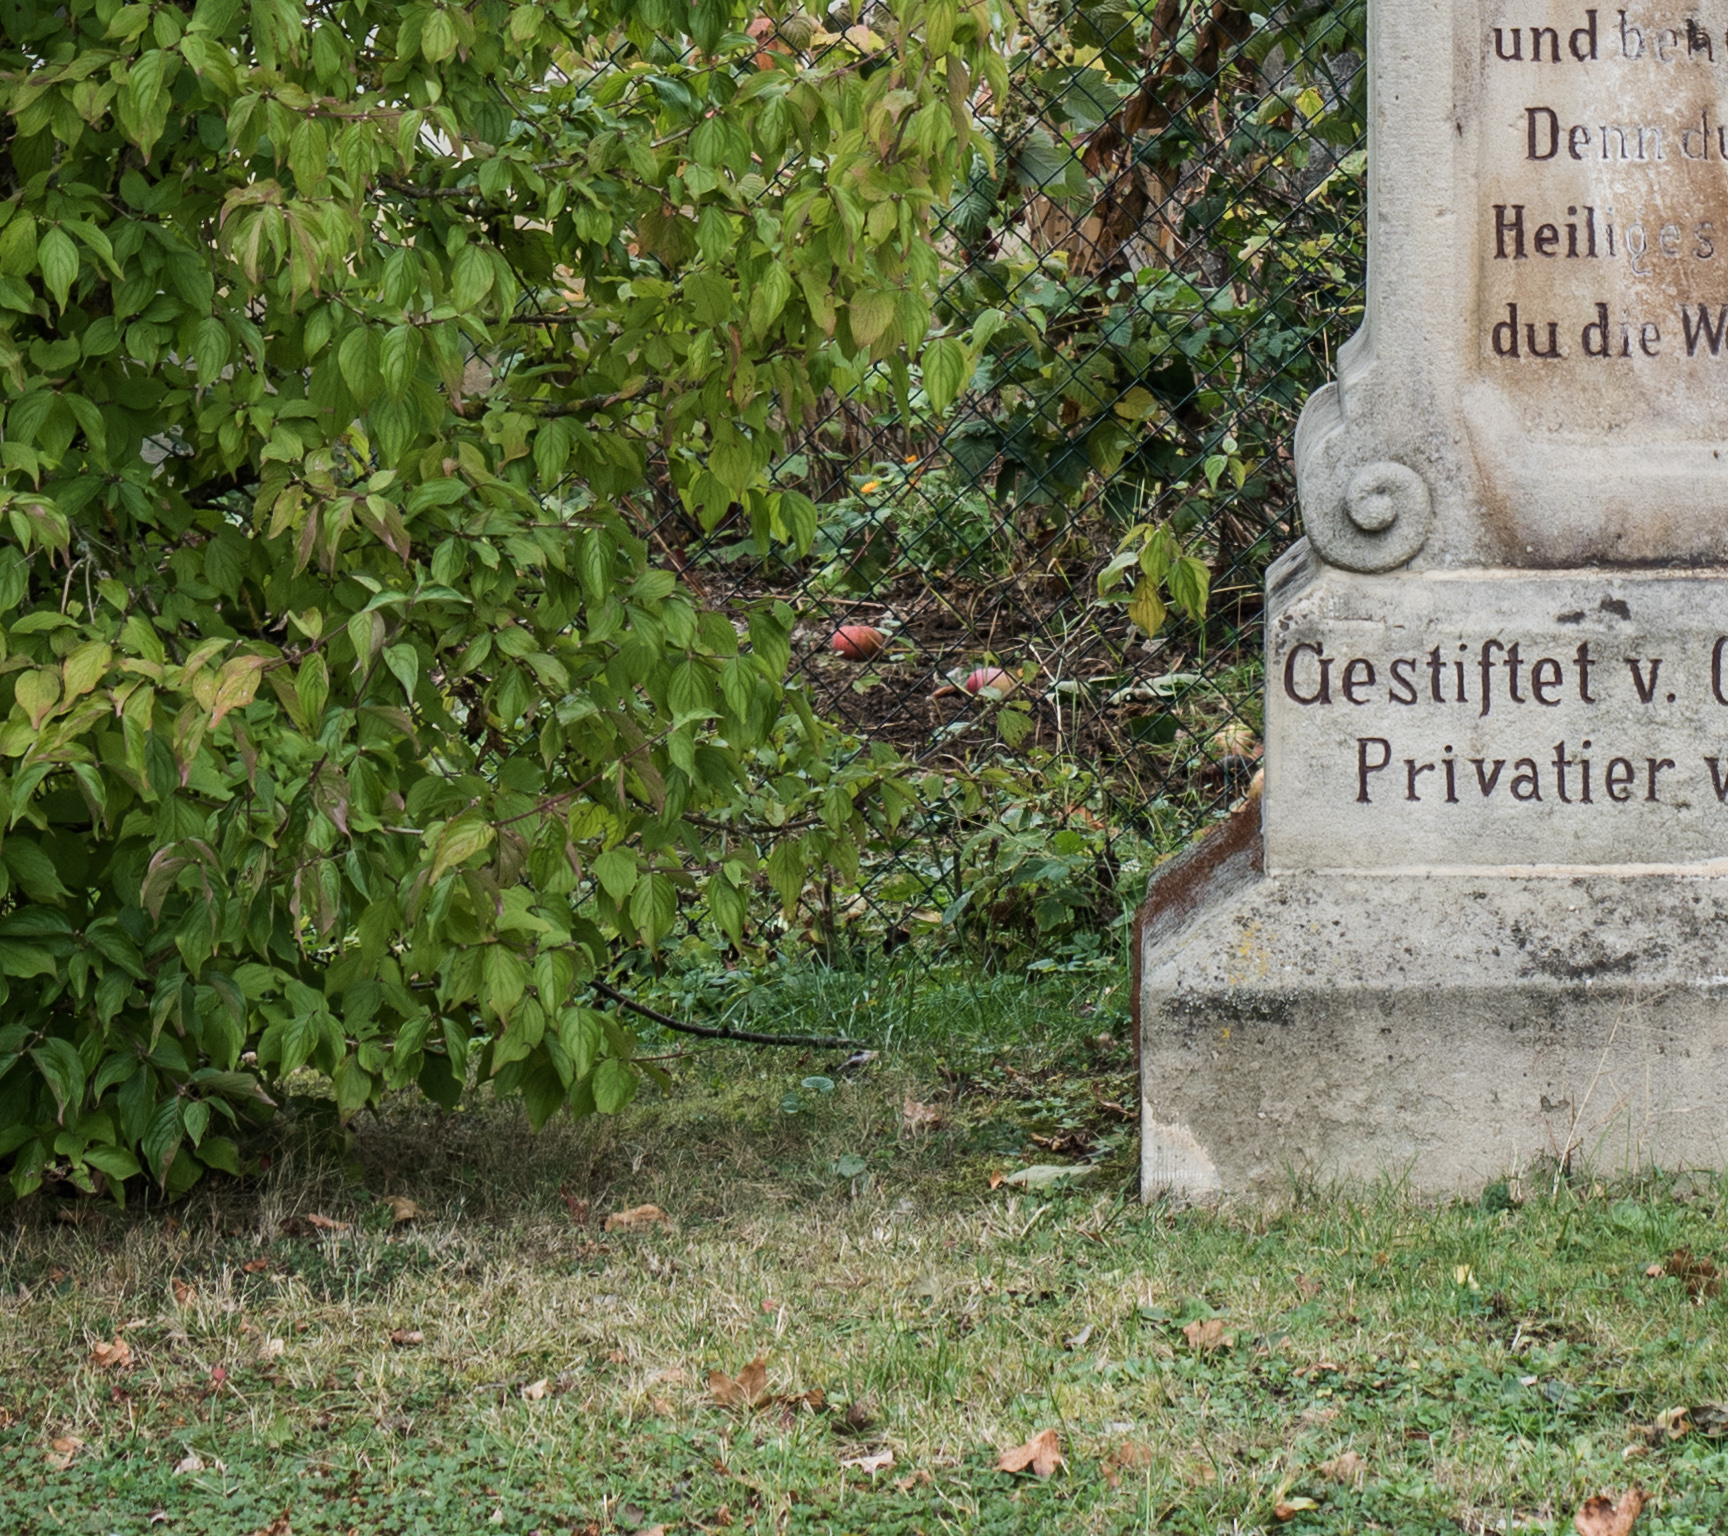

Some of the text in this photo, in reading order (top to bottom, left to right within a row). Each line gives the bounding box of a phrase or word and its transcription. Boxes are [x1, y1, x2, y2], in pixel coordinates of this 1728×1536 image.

[1493, 9, 1599, 63] und
[1523, 106, 1663, 161] Denn
[1491, 204, 1715, 276] Heiliges
[1491, 303, 1561, 358] du
[1581, 303, 1661, 358] die
[1283, 638, 1597, 718] Gestiftet
[1624, 658, 1676, 704] v.
[1356, 737, 1676, 803] Privatier
